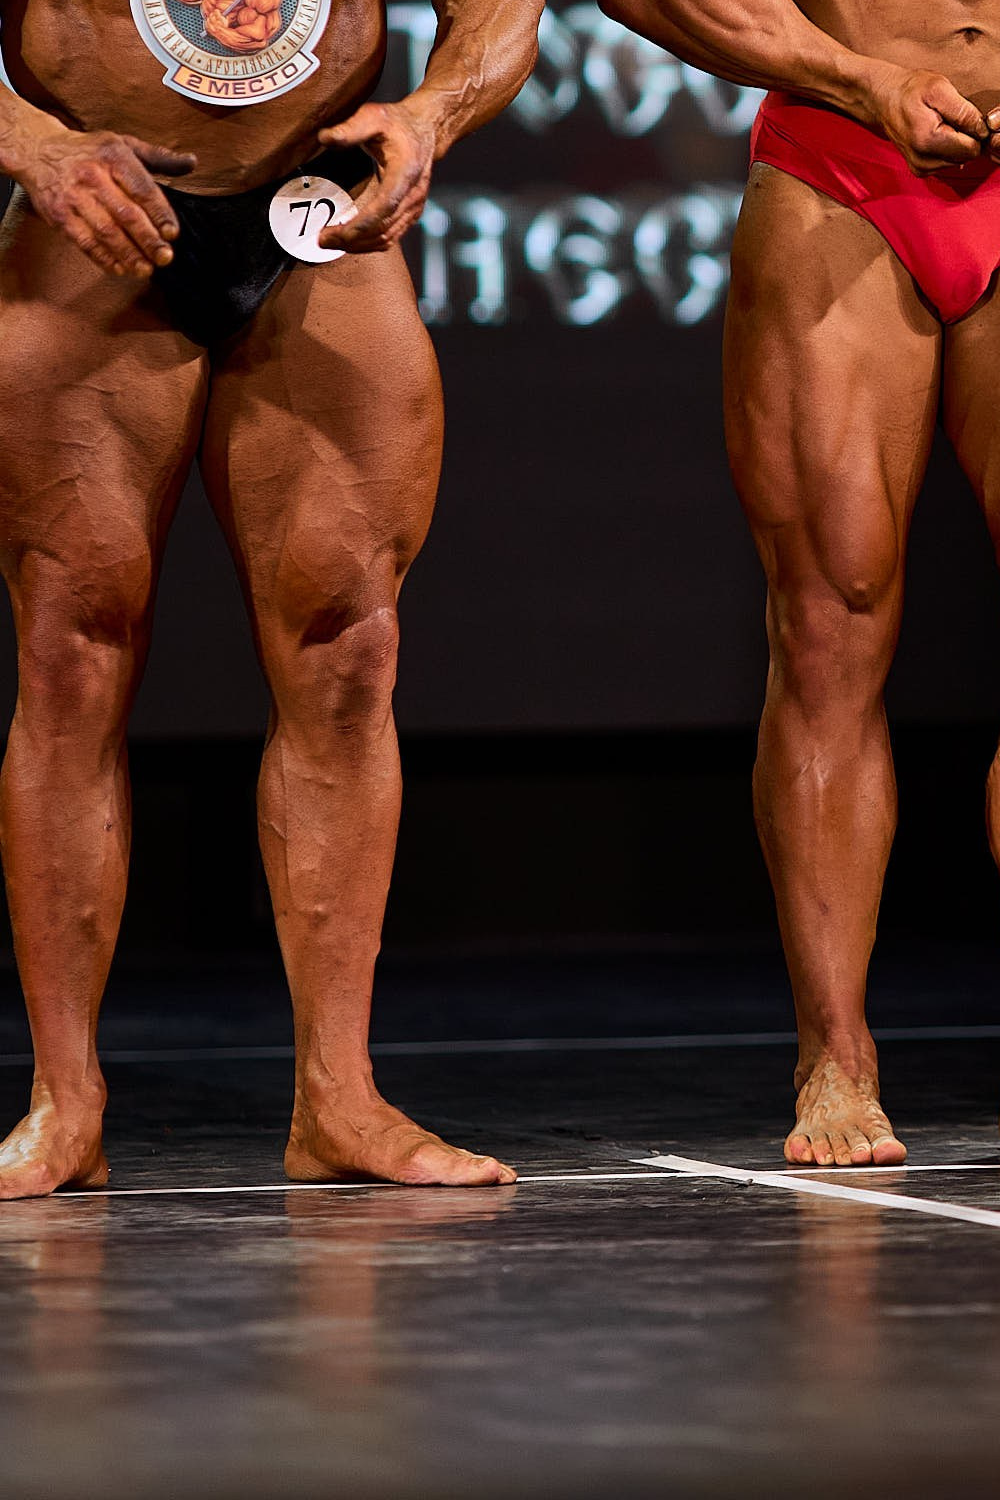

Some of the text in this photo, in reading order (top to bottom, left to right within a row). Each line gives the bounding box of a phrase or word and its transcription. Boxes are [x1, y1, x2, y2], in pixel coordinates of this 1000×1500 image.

[186, 61, 299, 96] 2 МЕСТО
[289, 198, 336, 237] 72
